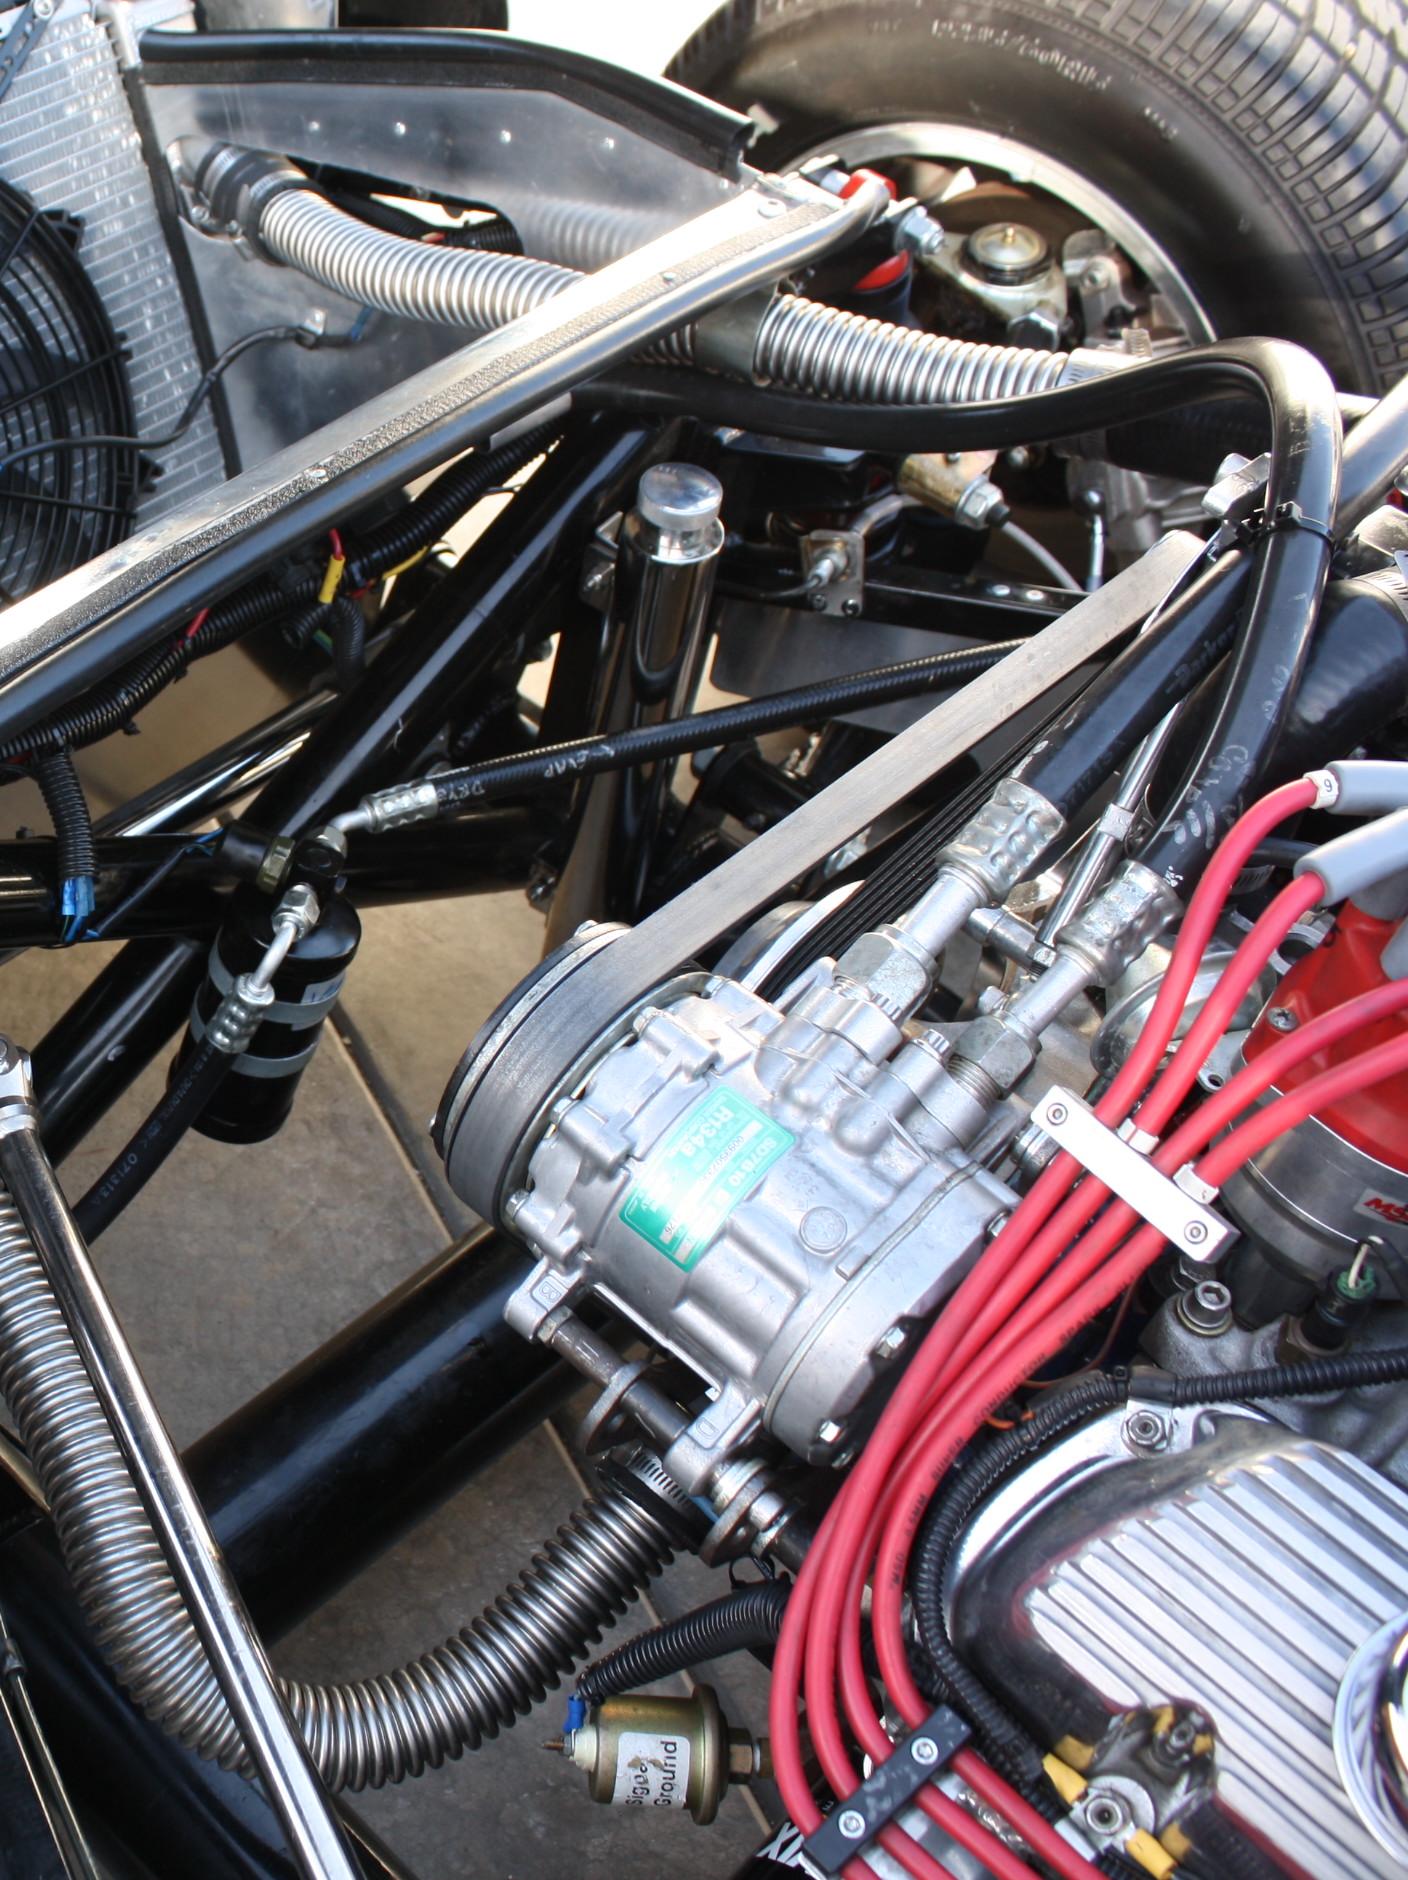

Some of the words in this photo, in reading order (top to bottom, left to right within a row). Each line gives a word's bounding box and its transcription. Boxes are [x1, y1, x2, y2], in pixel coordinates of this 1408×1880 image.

[680, 1104, 734, 1158] R134a
[726, 1135, 778, 1188] SD7B10
[653, 1740, 677, 1806] Ground
